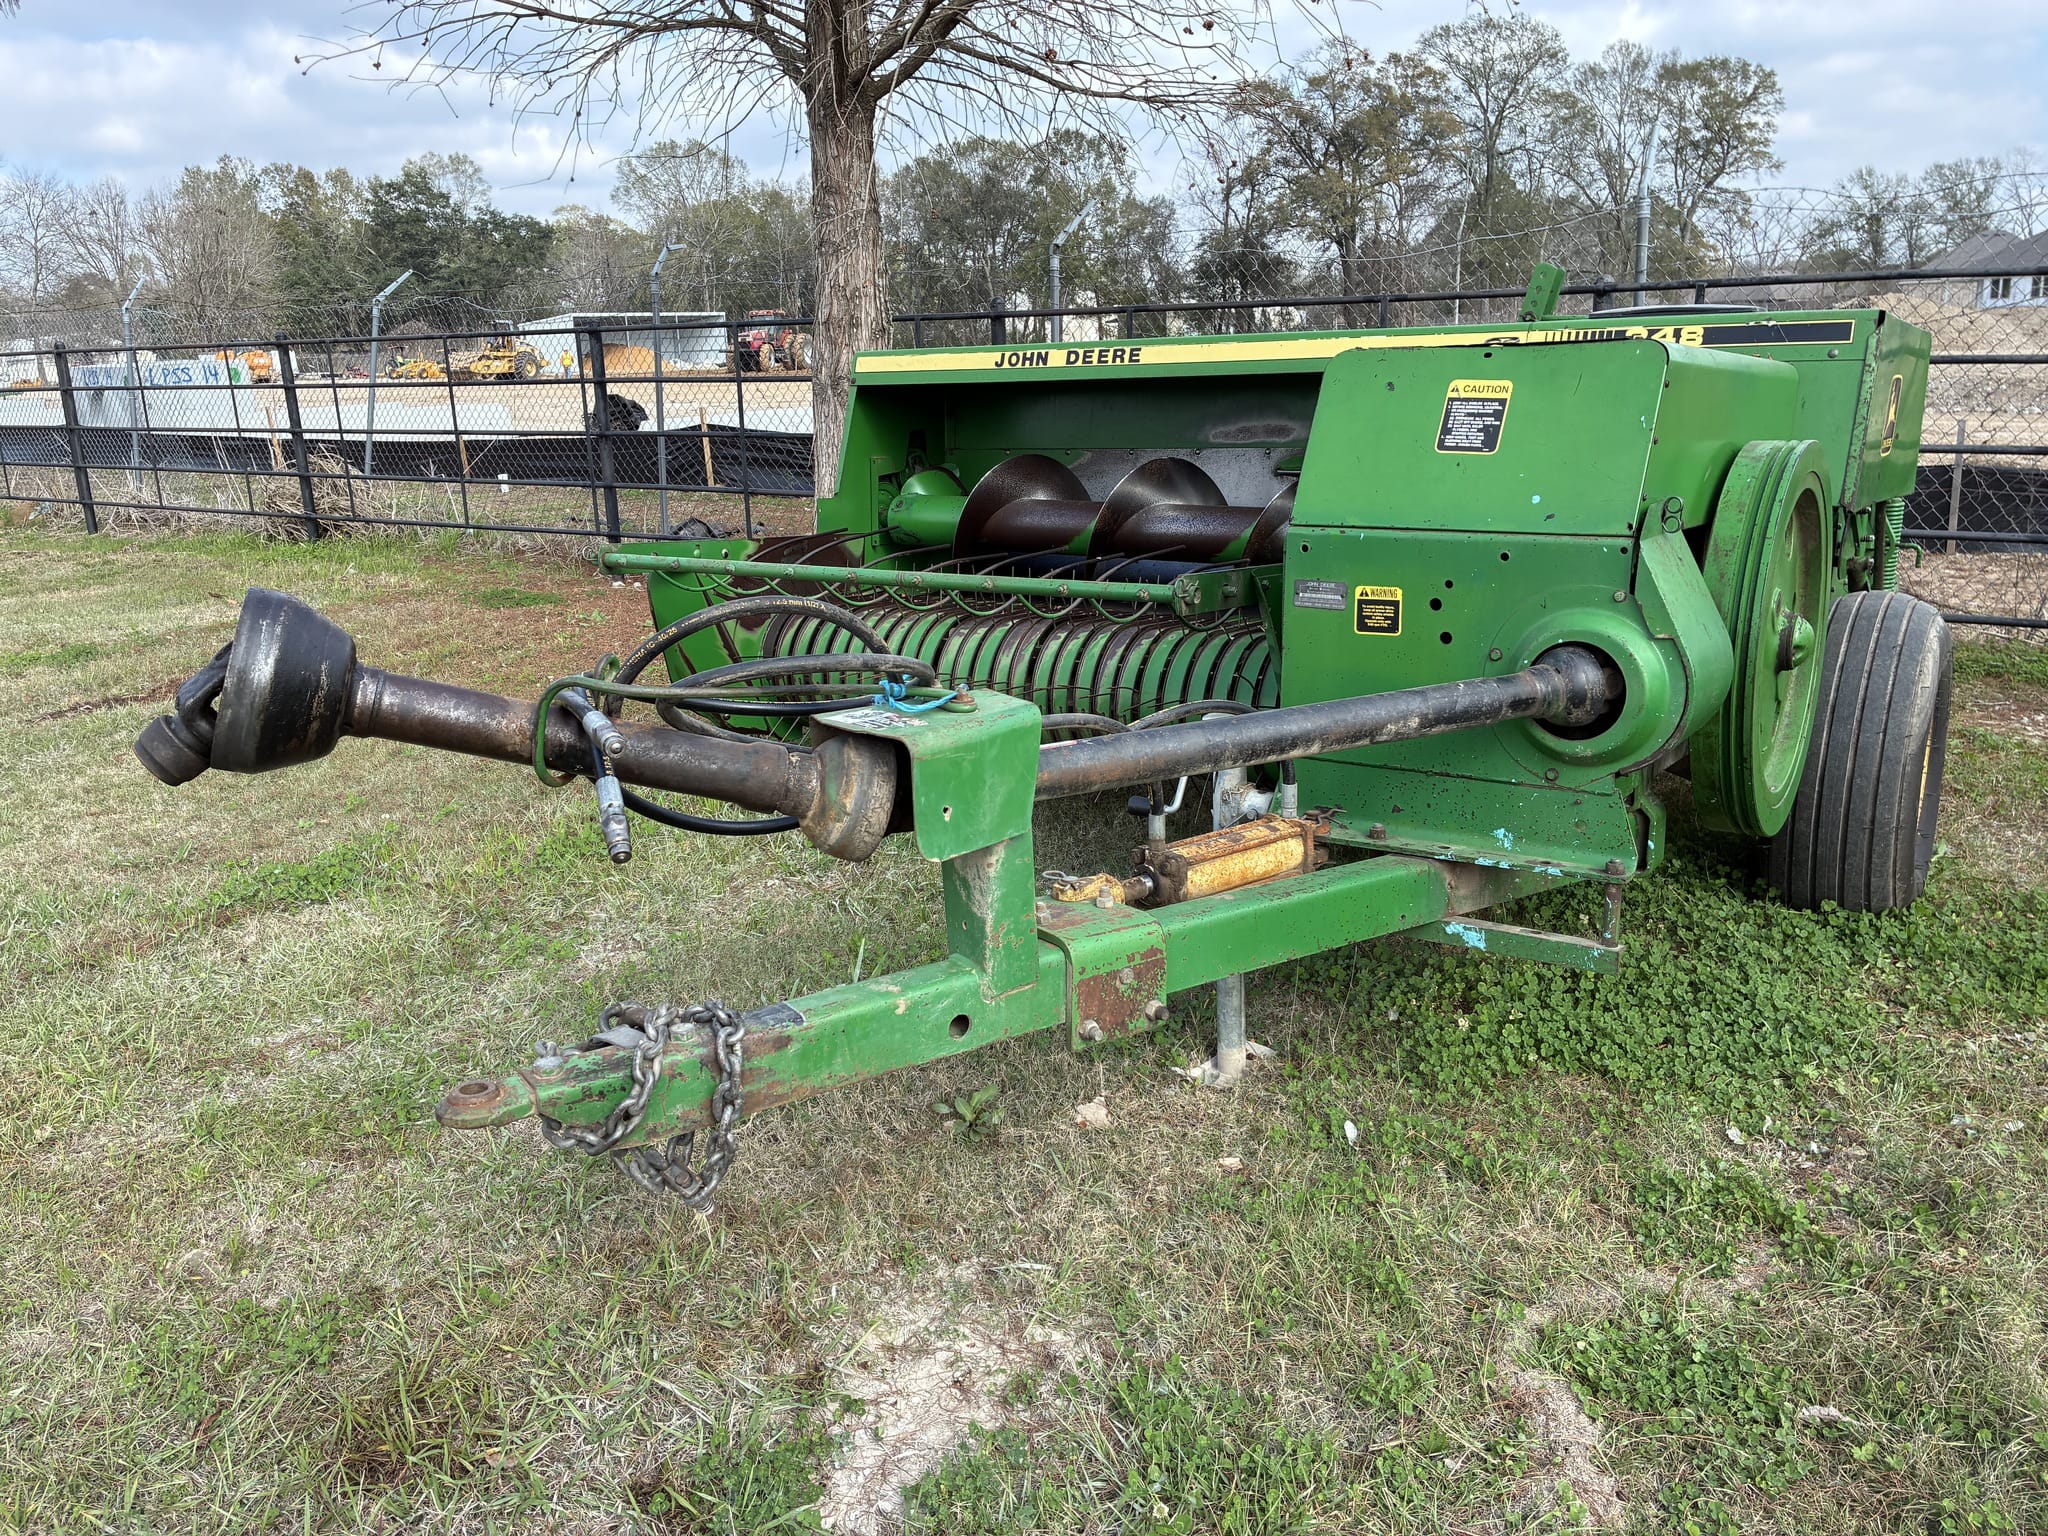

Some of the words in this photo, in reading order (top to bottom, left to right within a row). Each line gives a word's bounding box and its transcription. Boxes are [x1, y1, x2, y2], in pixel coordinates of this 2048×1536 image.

[994, 351, 1049, 367] JOHN
[1065, 347, 1142, 365] DEERE
[202, 364, 219, 384] 14
[1463, 384, 1510, 394] CAUTION
[1370, 587, 1398, 599] WARNING
